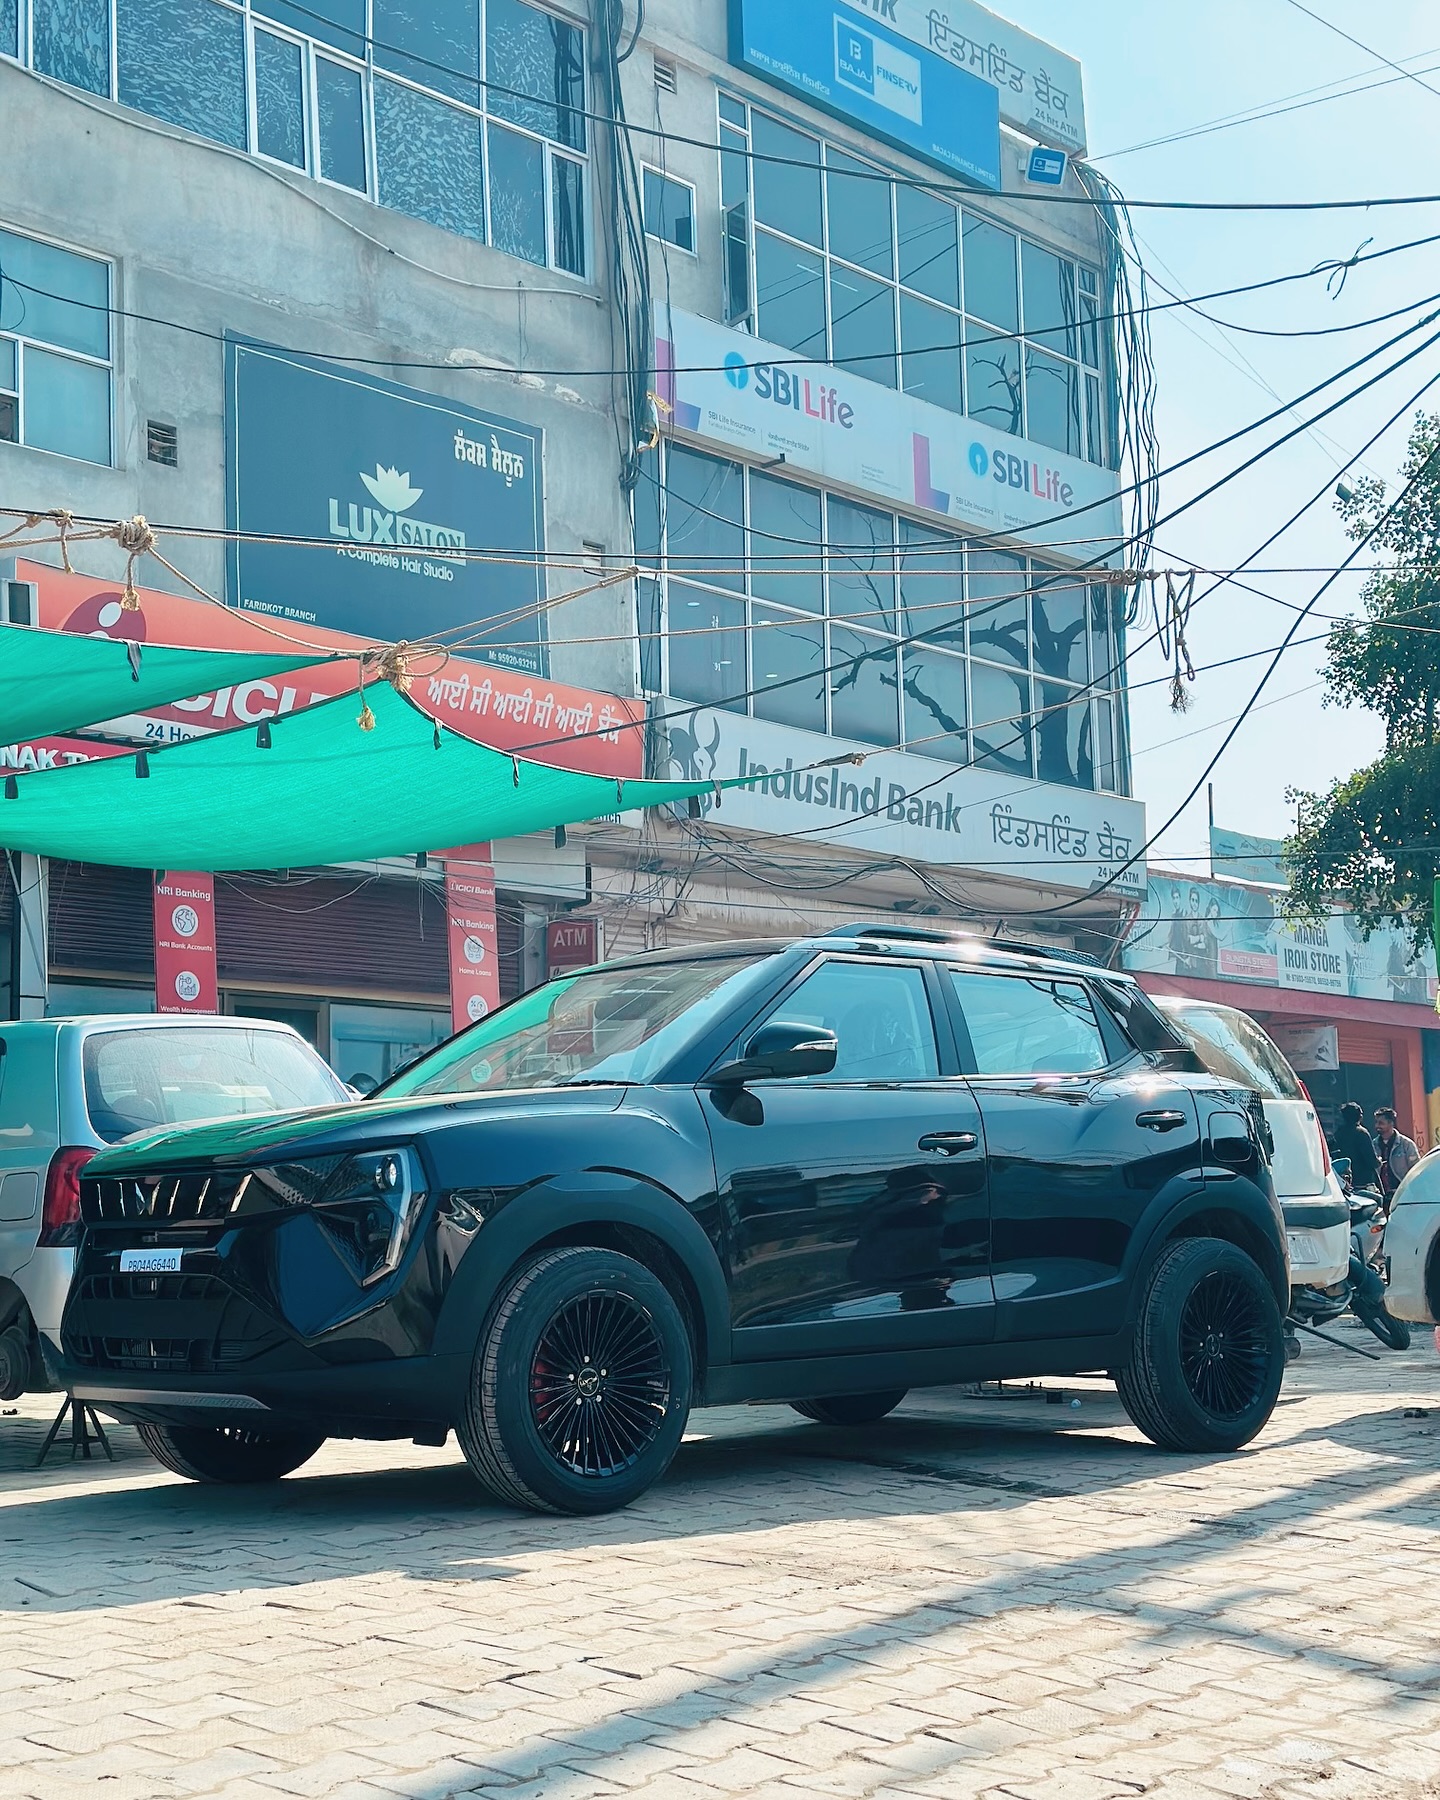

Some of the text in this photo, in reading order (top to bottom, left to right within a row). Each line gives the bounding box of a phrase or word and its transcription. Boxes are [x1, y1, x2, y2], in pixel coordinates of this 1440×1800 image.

[839, 58, 918, 95] BAJAJ FINSERV
[1032, 68, 1069, 118] ਬੈਂਕ
[1035, 107, 1046, 120] 24
[1046, 113, 1059, 128] hrs
[1060, 121, 1078, 138] ATM
[754, 363, 854, 430] SBI Life
[992, 449, 1074, 507] SBI Life
[329, 498, 463, 556] LUX SALON
[348, 542, 400, 570] Complete
[401, 556, 421, 574] Hair
[423, 561, 454, 582] Studio
[243, 598, 316, 622] FARIDKOT BRANCH
[146, 723, 164, 739] 24
[738, 747, 961, 833] IndusInd Bank
[1096, 821, 1132, 862] ਬੈਂਕ
[1097, 866, 1108, 879] 24
[1122, 871, 1140, 884] ATM
[157, 885, 211, 901] NRI Banking
[455, 884, 494, 896] ICICI Bank
[451, 917, 494, 932] NRI Banking
[1294, 925, 1329, 947] MANGA
[159, 940, 213, 952] NRI Bank Accounts
[553, 927, 587, 948] ATM
[458, 967, 492, 977] Home Loans
[1284, 948, 1308, 970] IRON
[1310, 952, 1341, 974] STORE
[160, 1005, 216, 1014] Wealth Management
